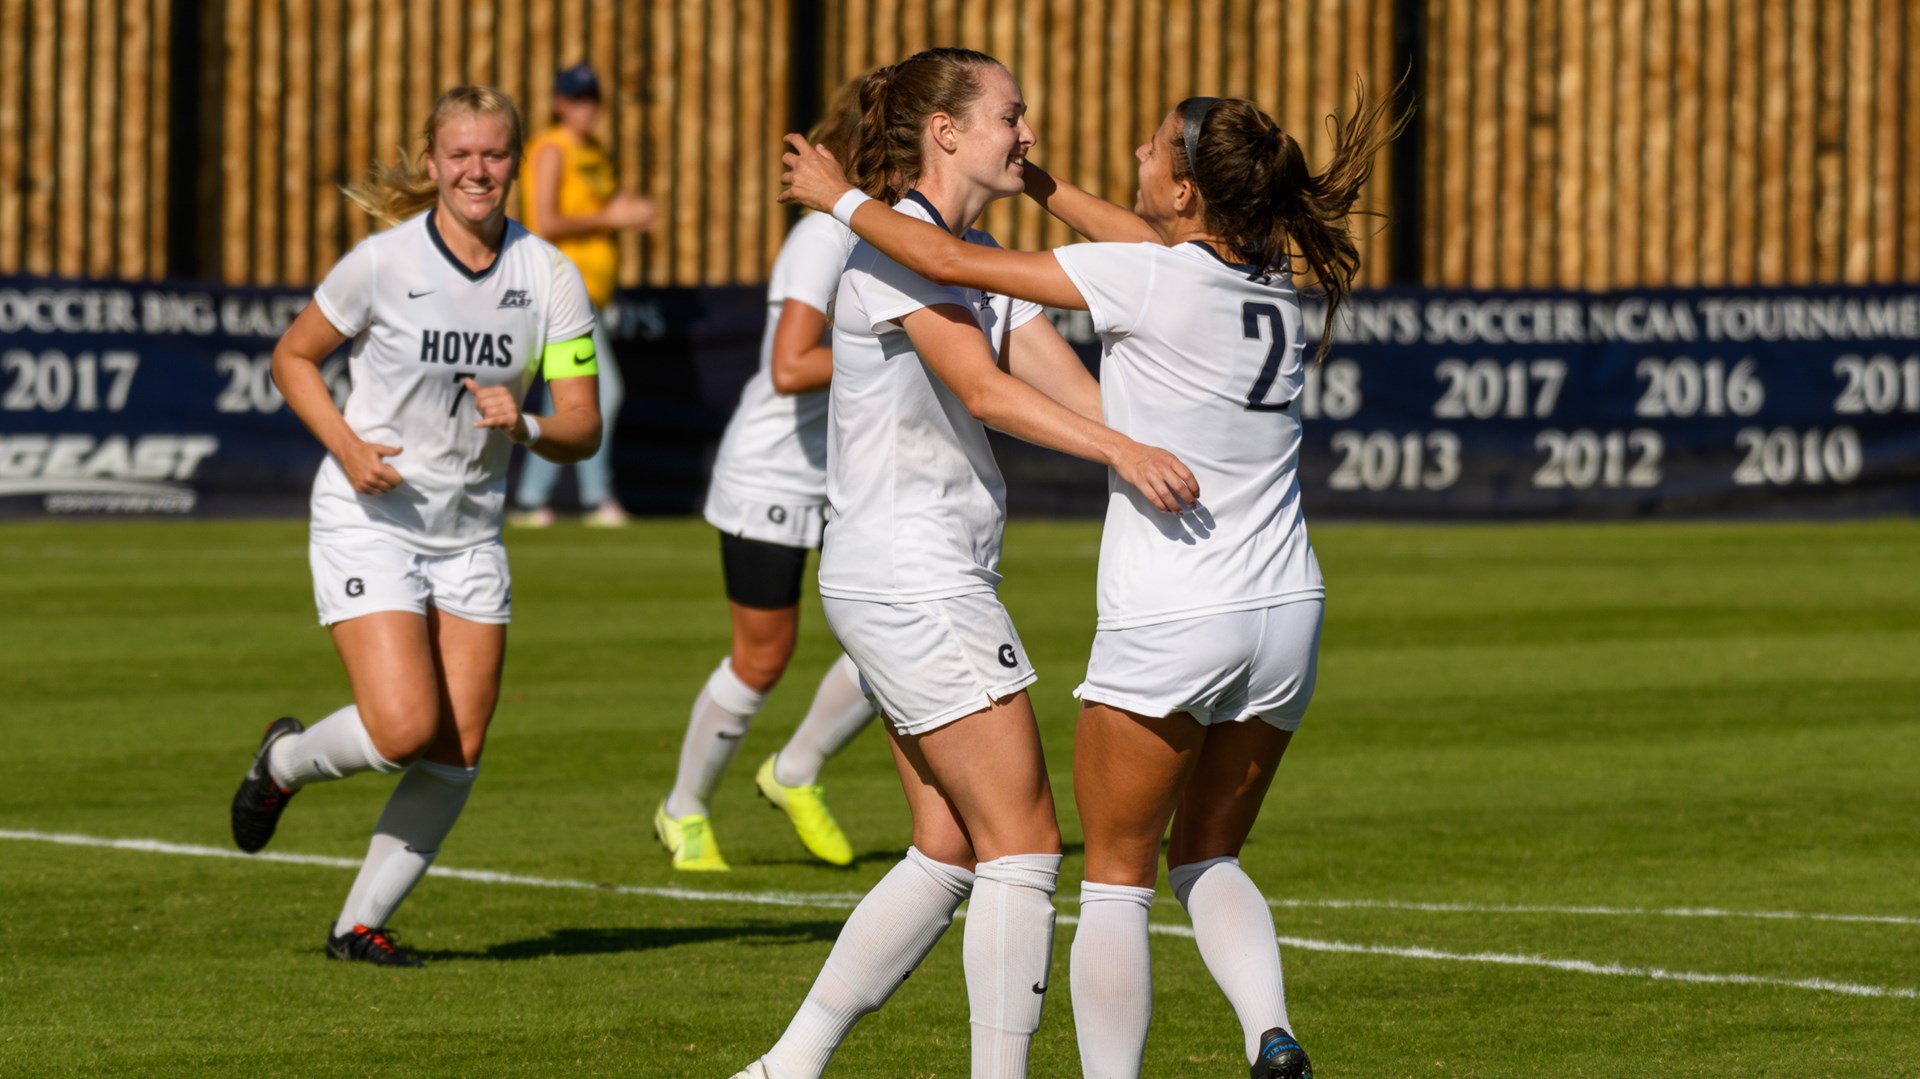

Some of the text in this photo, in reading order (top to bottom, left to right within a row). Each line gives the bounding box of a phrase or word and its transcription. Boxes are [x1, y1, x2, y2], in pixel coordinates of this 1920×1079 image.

[142, 291, 217, 336] BIG
[221, 296, 312, 337] EAS
[500, 298, 533, 307] EAST
[504, 289, 528, 298] BIG
[1424, 300, 1586, 345] SOCCER
[1588, 298, 1698, 343] NCAA
[420, 330, 513, 368] HOYAS
[1241, 299, 1293, 412] 2
[2, 350, 139, 412] 2017
[449, 373, 476, 418] 7
[1432, 357, 1567, 420] 2017
[1635, 356, 1765, 418] 2016
[1327, 425, 1863, 491] 2013 2012 2010
[767, 505, 787, 525] G
[345, 577, 365, 598] G
[998, 643, 1018, 669] G
